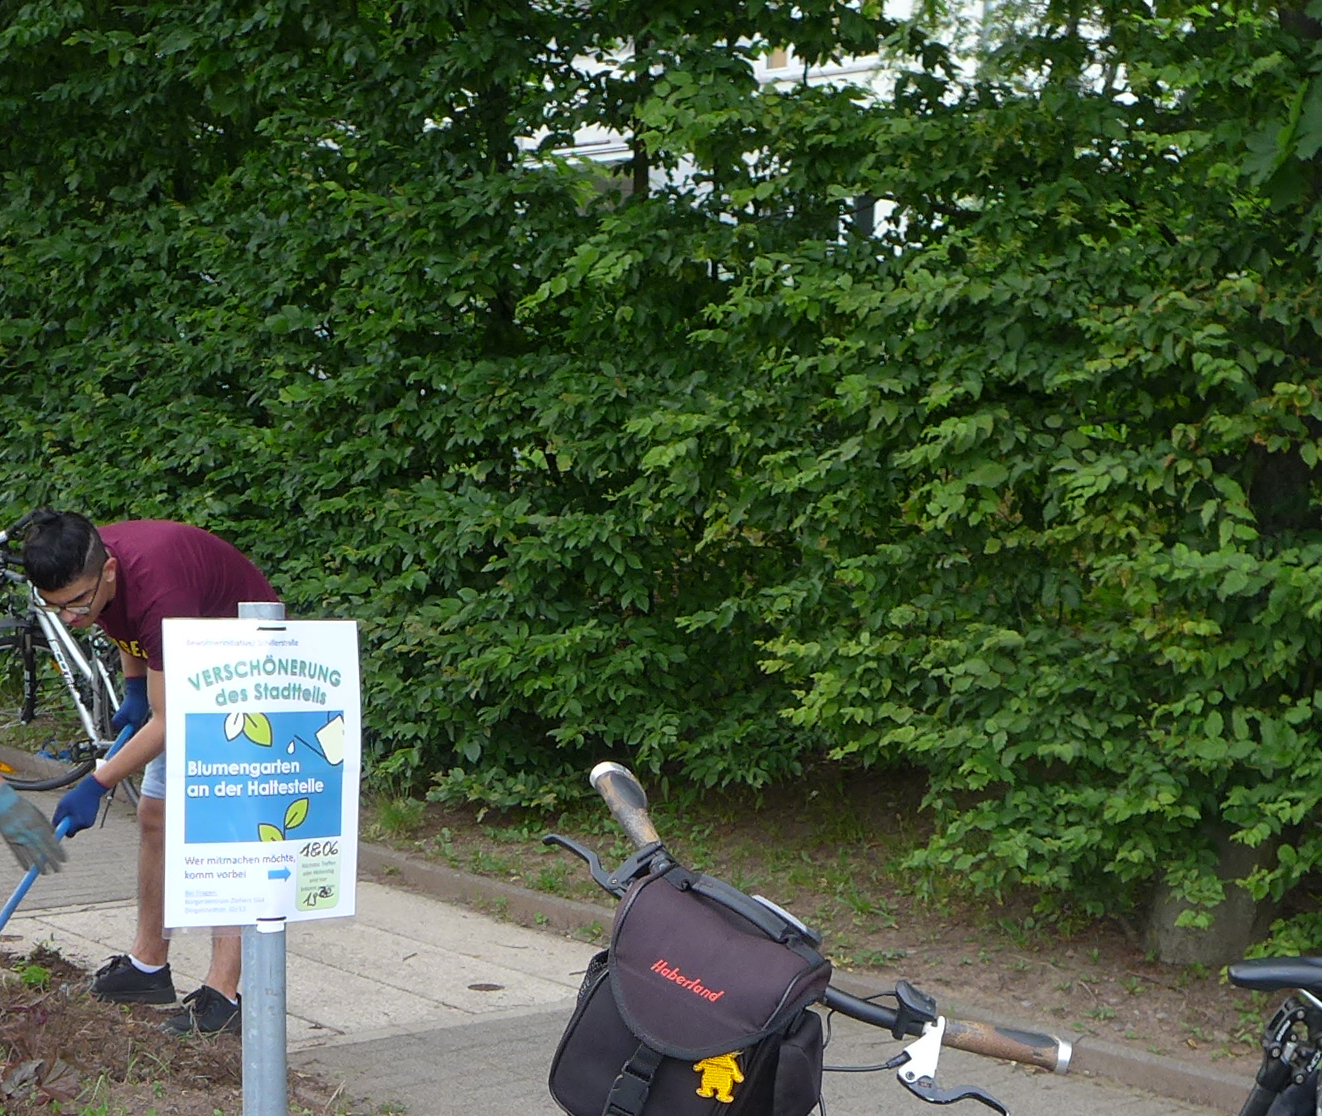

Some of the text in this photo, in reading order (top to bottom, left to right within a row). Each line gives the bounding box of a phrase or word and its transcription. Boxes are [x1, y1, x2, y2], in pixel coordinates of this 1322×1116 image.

[188, 654, 342, 691] VERSCHÖNERUNG
[215, 682, 327, 707] des Stadtteils
[187, 759, 300, 778] Blumengarten
[187, 778, 325, 797] an der Haltestelle
[185, 856, 205, 865] Wer
[207, 855, 260, 865] mitmachen
[185, 869, 247, 879] komm vorbei
[650, 959, 725, 1002] Haberland
